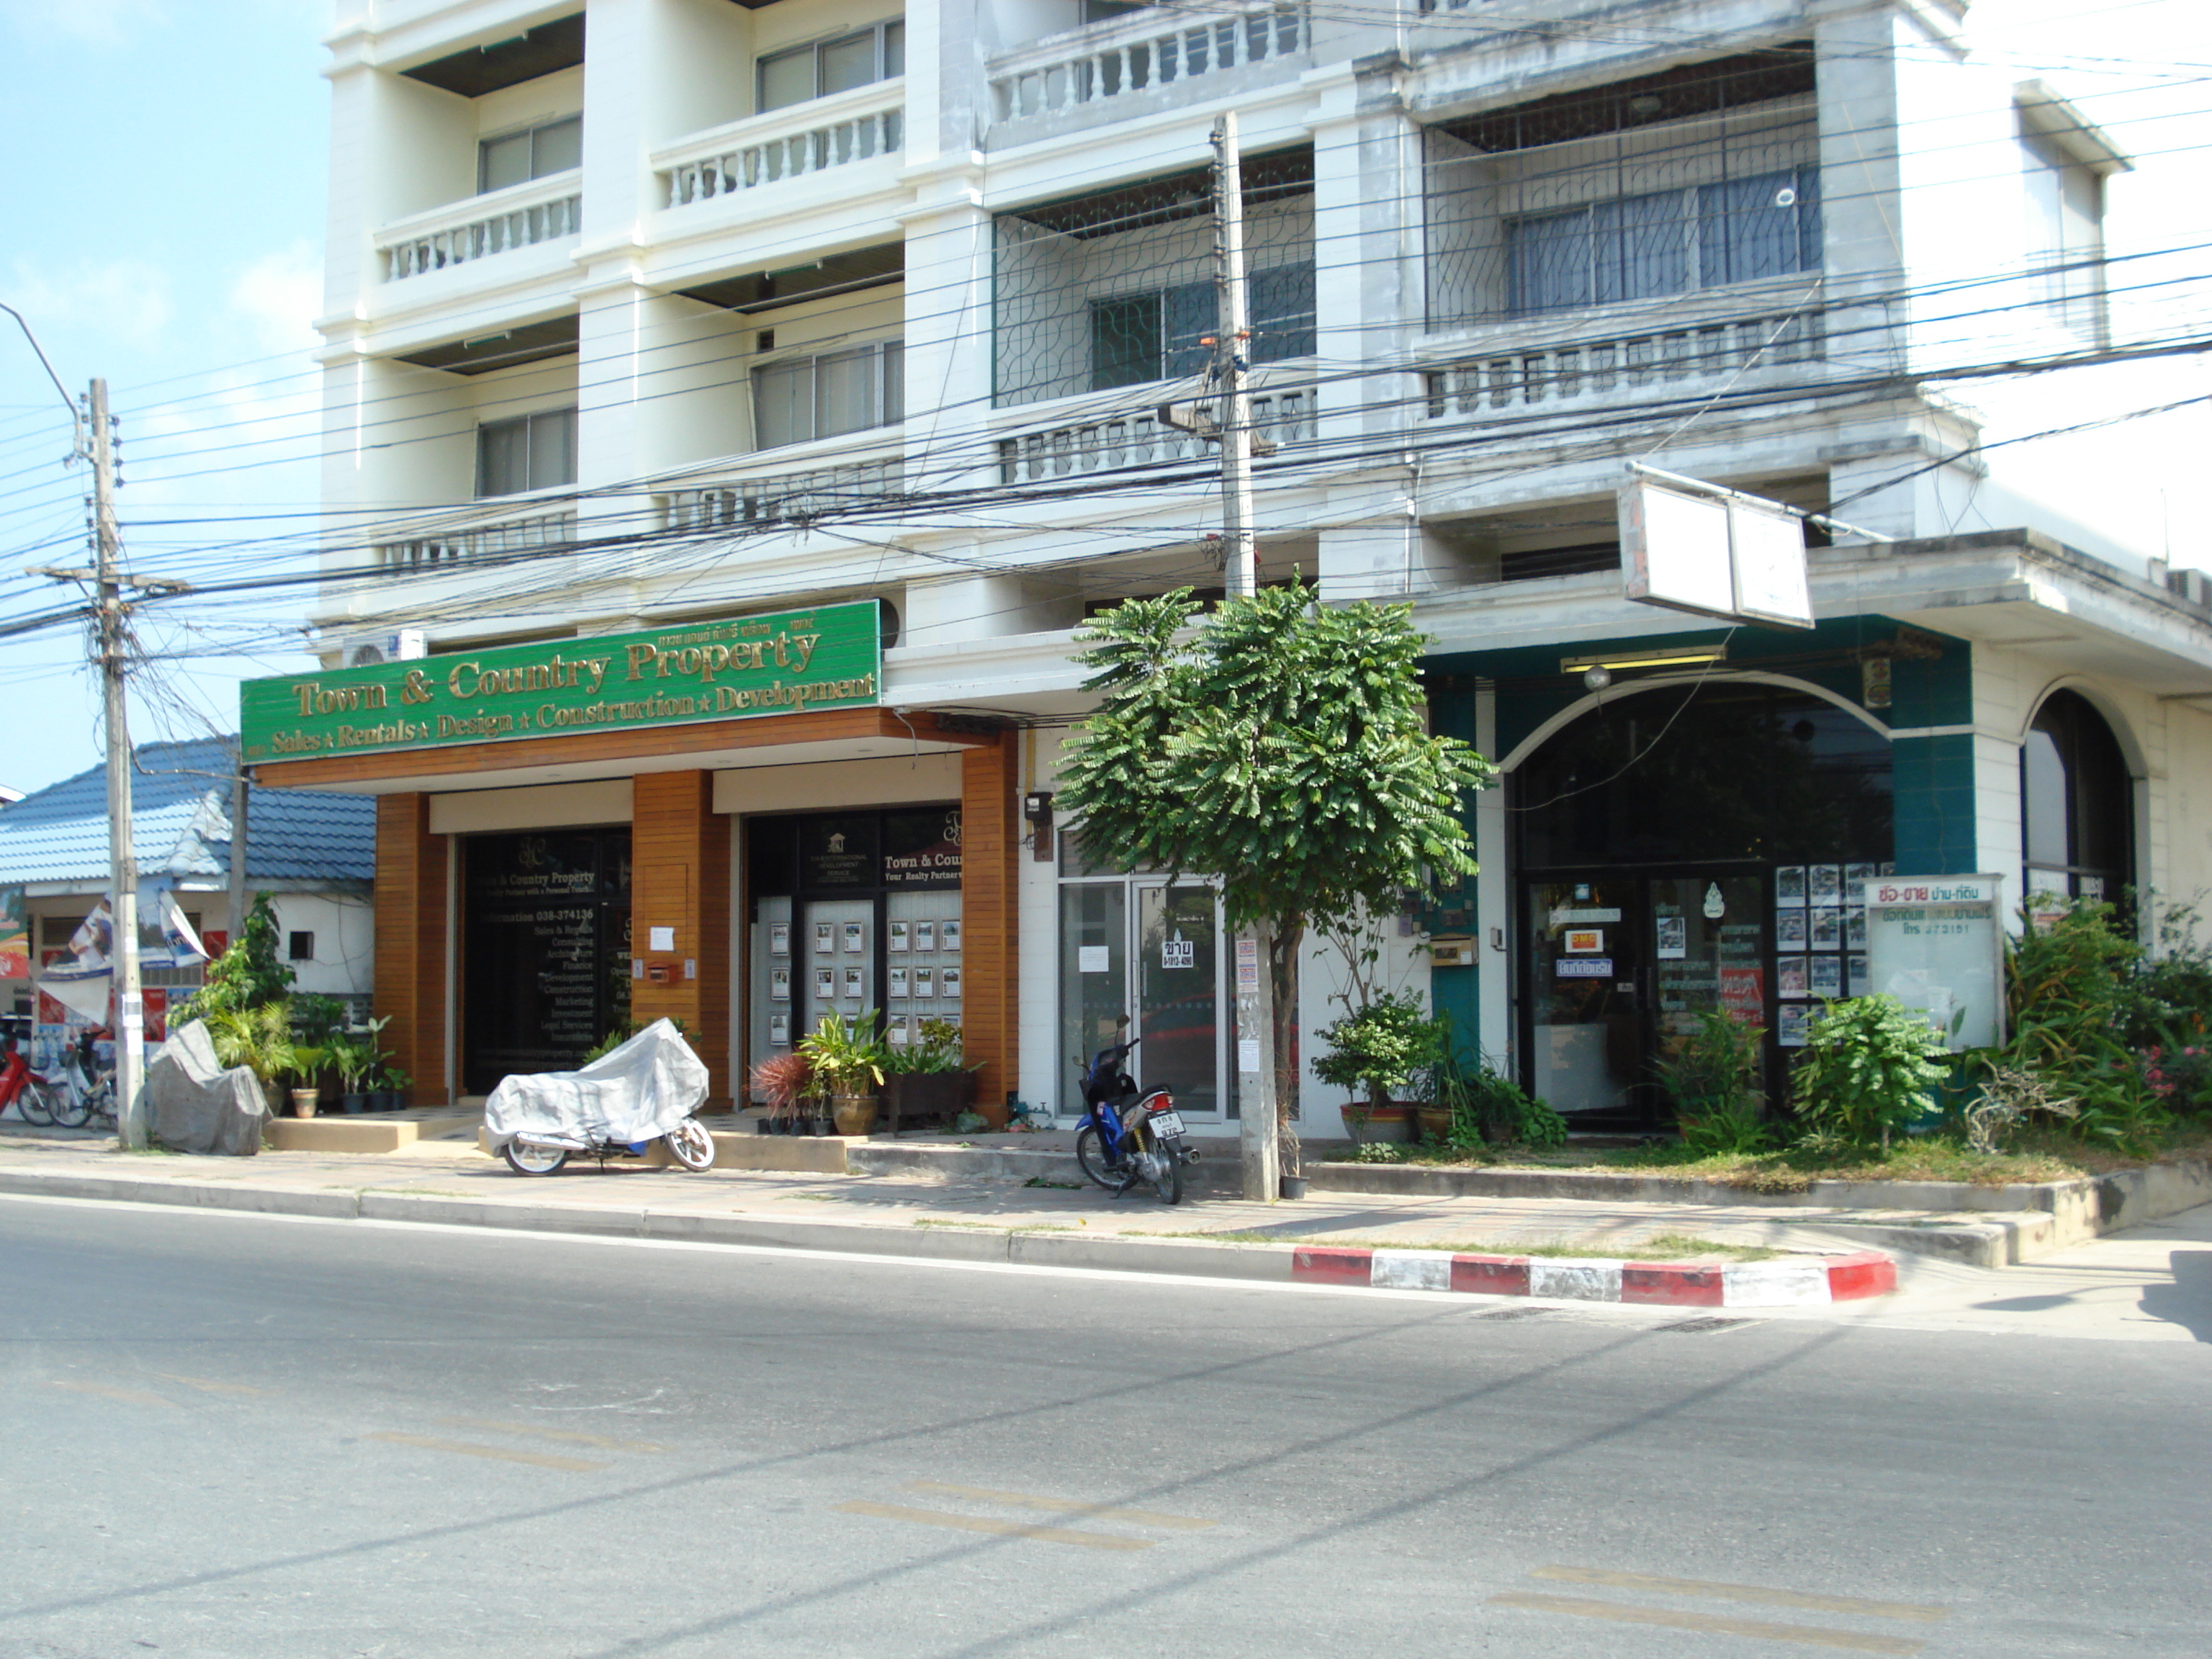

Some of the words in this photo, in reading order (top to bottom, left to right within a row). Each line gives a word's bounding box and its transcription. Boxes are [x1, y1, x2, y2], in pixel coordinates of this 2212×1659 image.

[292, 682, 387, 717] Town
[400, 669, 433, 706] &
[448, 654, 611, 698] Country
[625, 631, 822, 683] Property
[271, 729, 321, 755] Sales
[337, 719, 416, 749] Rentals
[436, 708, 513, 739] Design
[536, 690, 695, 730] Construction
[715, 673, 876, 712] Development
[885, 855, 917, 869] Town
[921, 854, 932, 867] &
[509, 873, 549, 886] Country
[551, 871, 595, 886] Property
[885, 872, 902, 881] Your
[905, 872, 928, 882] Realty
[931, 871, 958, 880] Partner
[536, 909, 594, 922] 038-374136
[1572, 934, 1596, 943] DMC
[1165, 943, 1190, 955] ขาย
[562, 961, 593, 970] Finance
[545, 974, 593, 984] Development
[544, 986, 593, 994] Construction
[554, 997, 593, 1007] Marketing
[551, 1009, 593, 1017] Investment
[562, 1020, 593, 1030] Services
